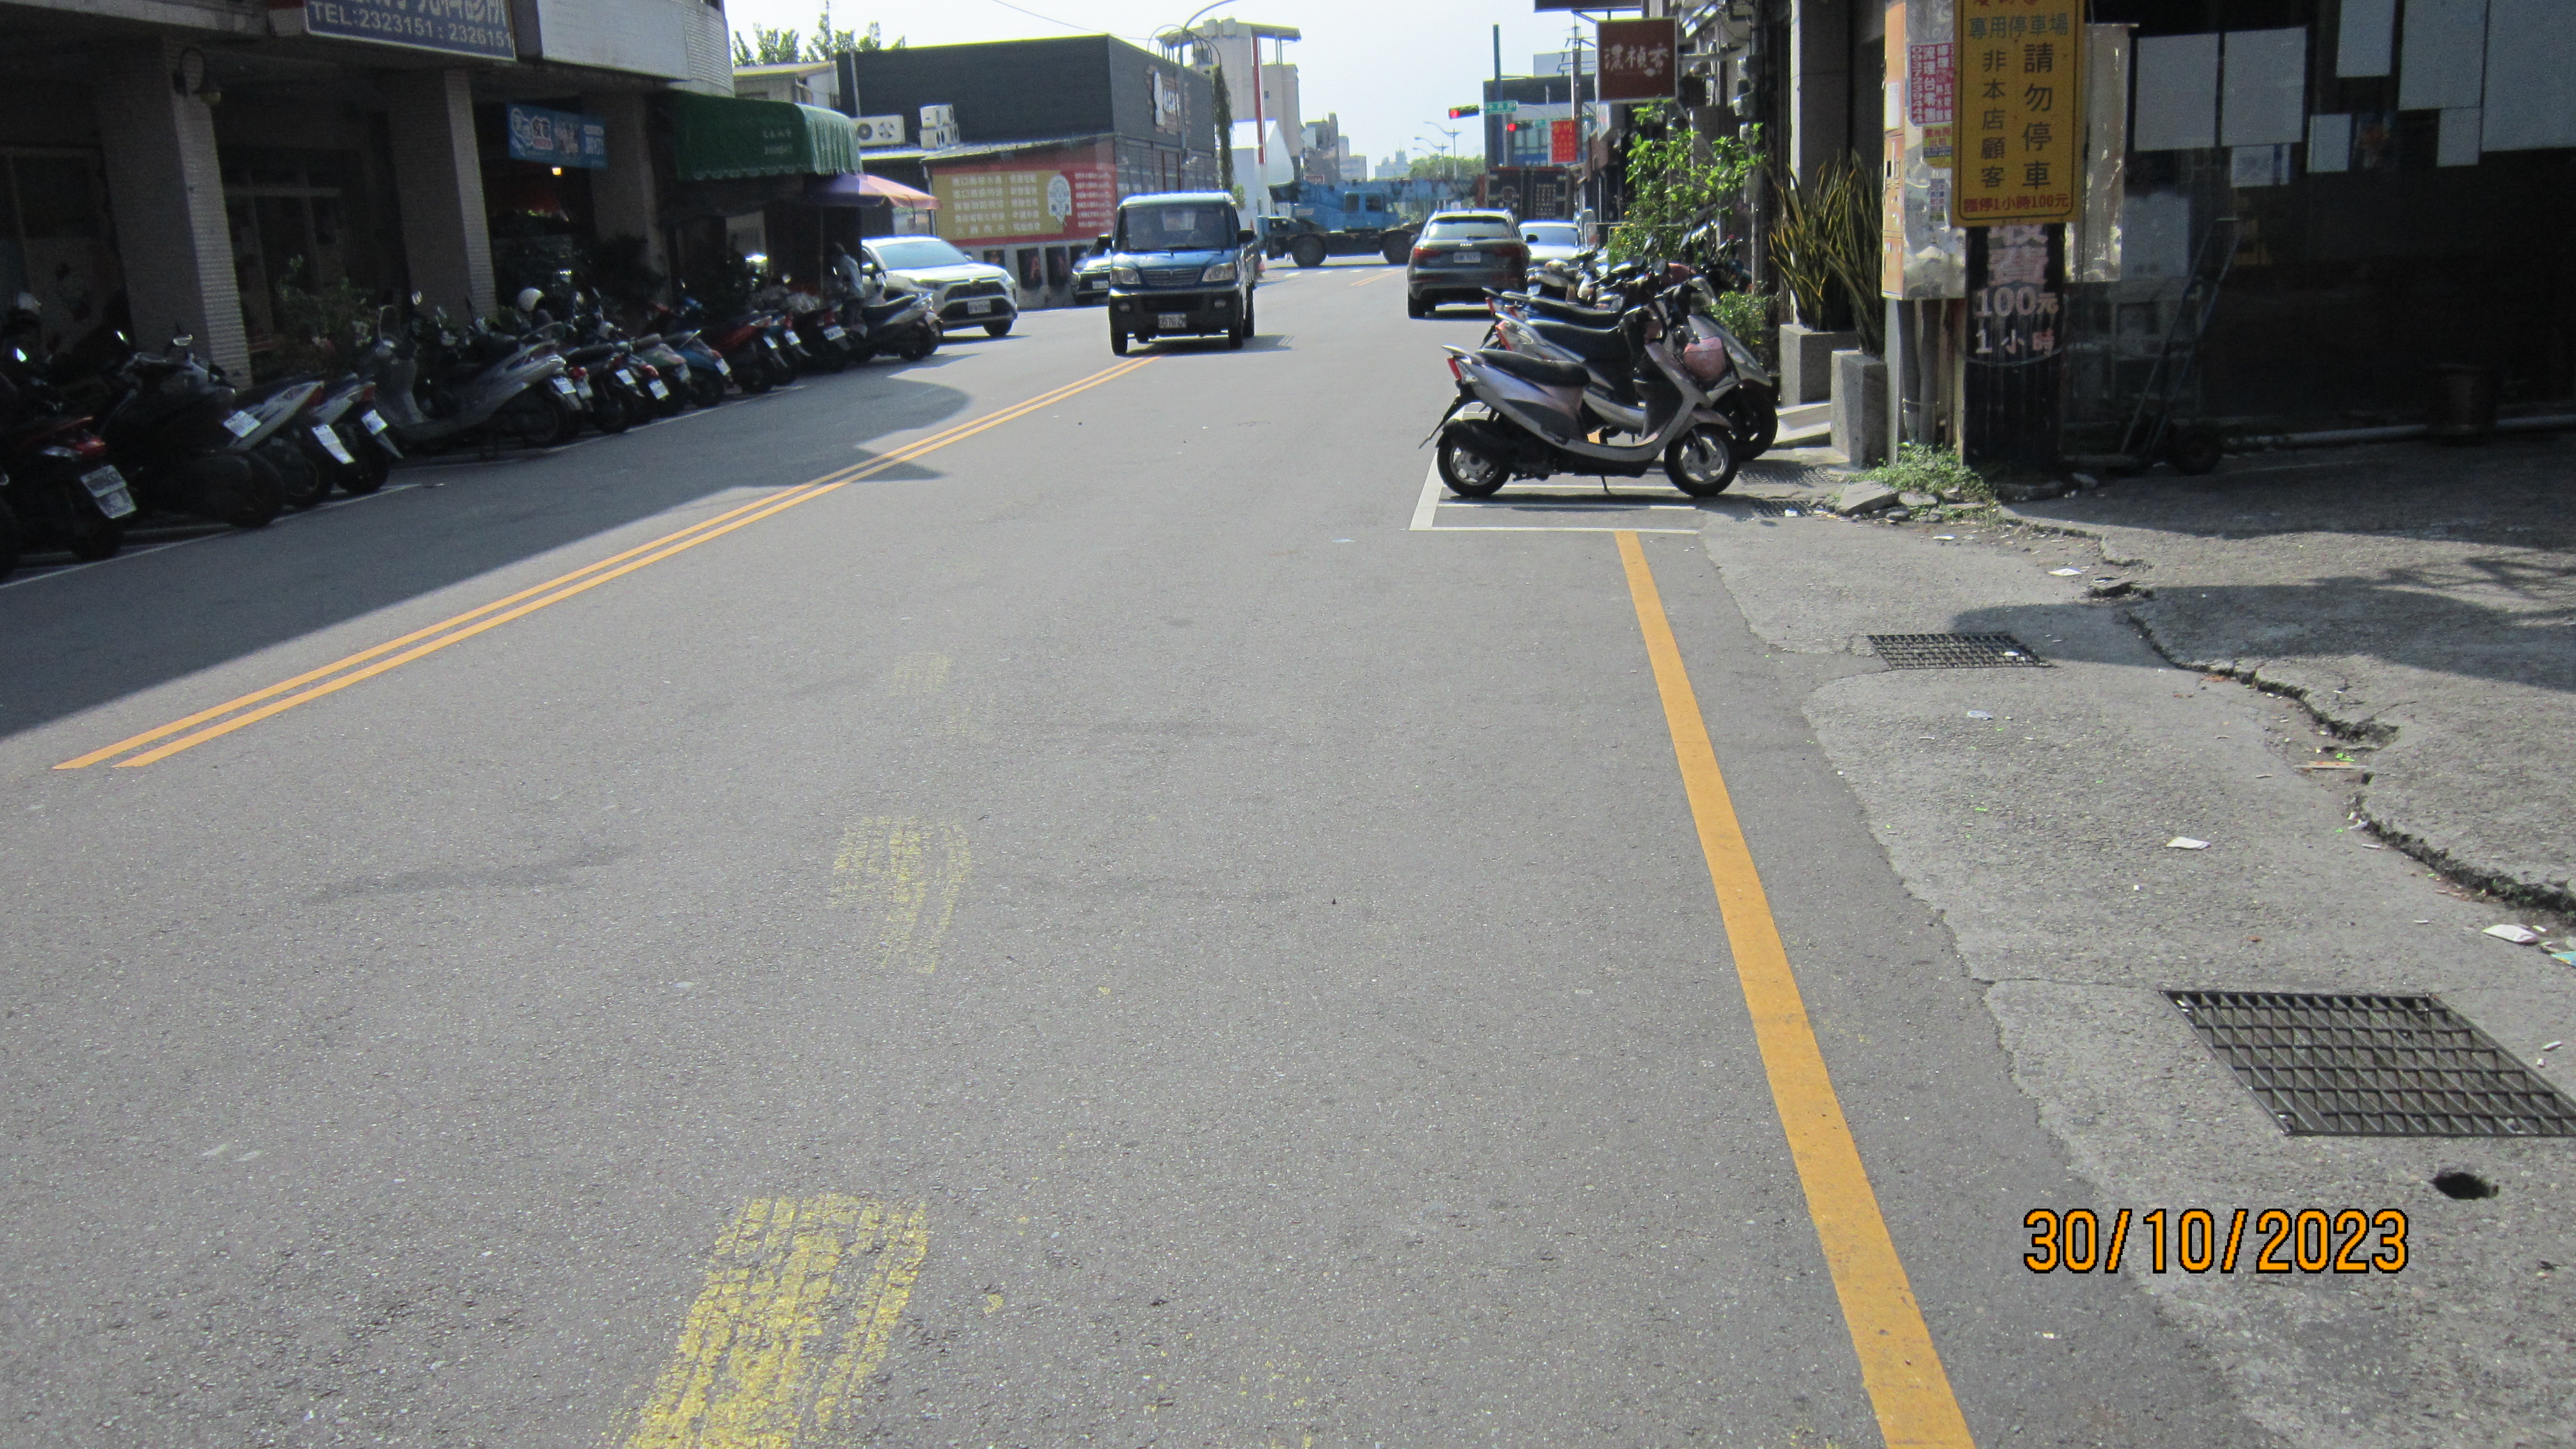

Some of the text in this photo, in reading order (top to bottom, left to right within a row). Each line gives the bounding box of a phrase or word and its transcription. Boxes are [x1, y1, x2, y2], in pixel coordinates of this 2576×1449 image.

[1969, 12, 2068, 40] 專用停車場
[1981, 49, 2006, 189] 非本店顧客
[2022, 42, 2053, 190] 請勿停車
[1975, 286, 2059, 317] 100元
